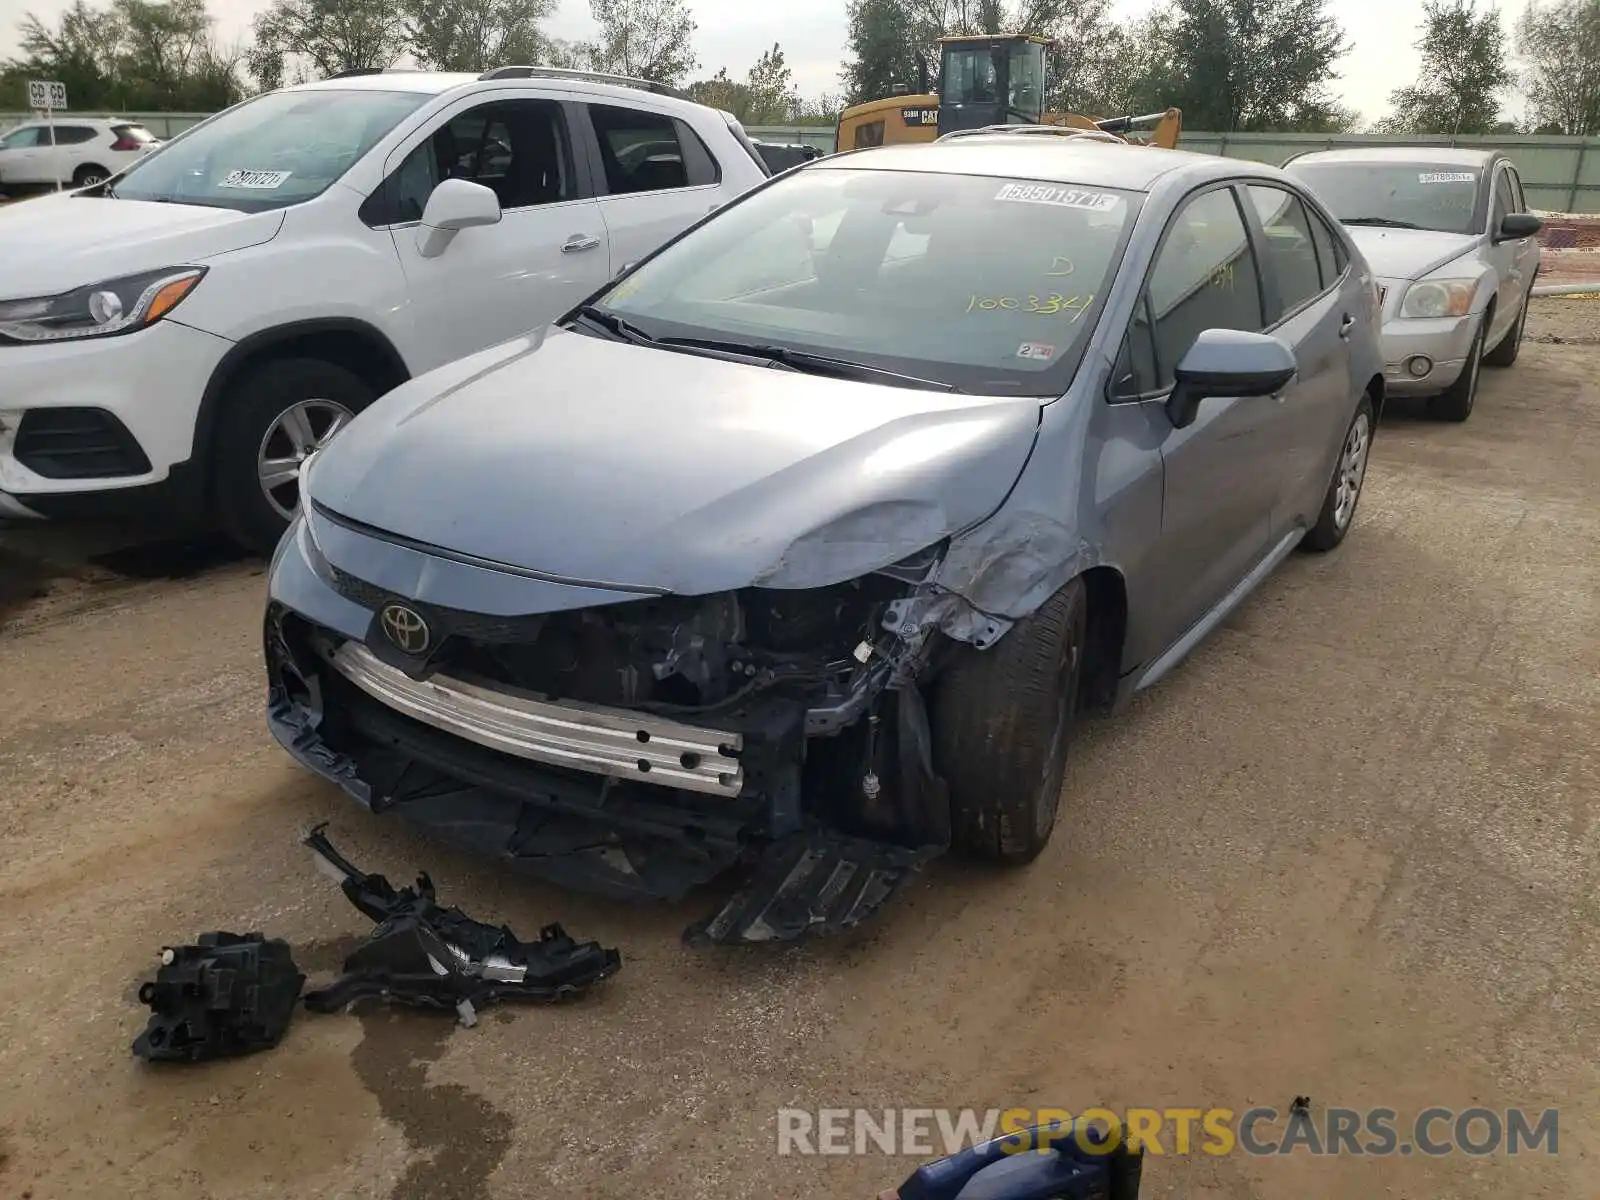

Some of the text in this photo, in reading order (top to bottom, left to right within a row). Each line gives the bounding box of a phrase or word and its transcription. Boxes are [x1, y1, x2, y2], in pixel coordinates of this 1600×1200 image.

[31, 83, 64, 99] CD CD
[921, 110, 939, 124] CAT
[1044, 256, 1075, 276] D
